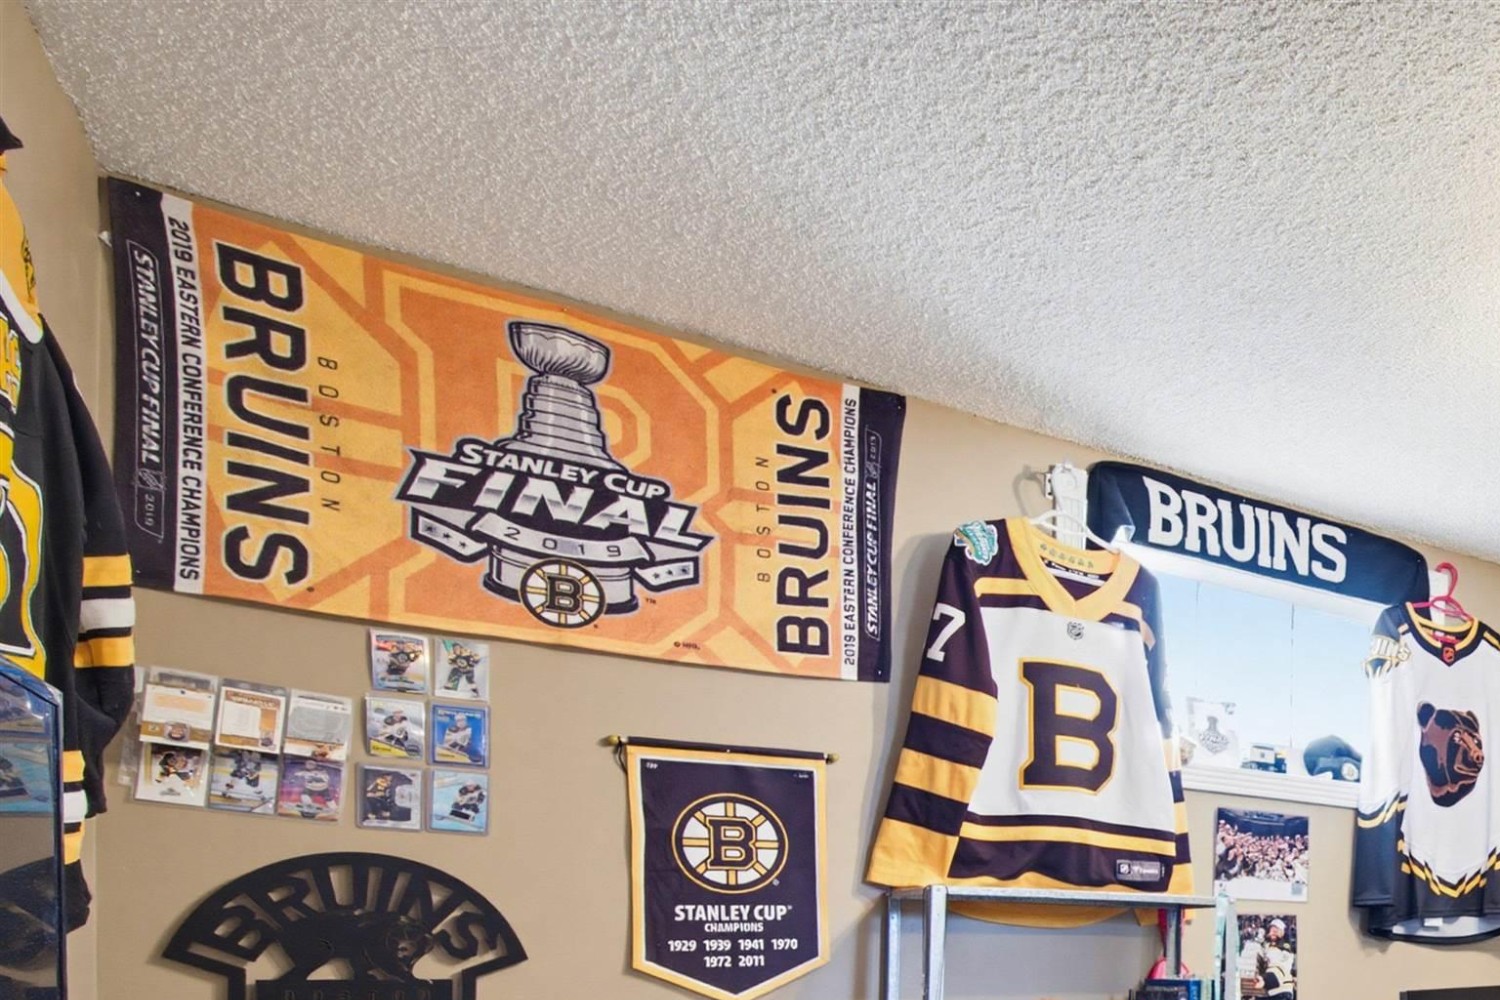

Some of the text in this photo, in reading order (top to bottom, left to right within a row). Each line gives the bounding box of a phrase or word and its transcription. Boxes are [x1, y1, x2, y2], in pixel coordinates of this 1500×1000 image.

[132, 248, 161, 353] STANLEY
[142, 353, 162, 402] CUP
[168, 215, 202, 581] 2019 EASTERN CONFERENCE CHAMPIONS
[215, 242, 310, 586] BRUINS
[142, 401, 163, 464] FINAL
[317, 356, 342, 512] BOSTON
[460, 444, 666, 499] STANLEY CUP
[407, 458, 703, 547] FINAL
[504, 526, 622, 558] 2019
[755, 456, 771, 582] BOSTON
[776, 394, 831, 656] BRUINS
[842, 399, 857, 665] 2019 EASTERN CONFERENCE CHAMPIONS
[865, 482, 877, 531] FINAL
[1143, 475, 1347, 583] BRUINS
[865, 532, 878, 564] CUP
[865, 564, 879, 635] STANLEY
[1019, 657, 1120, 796] B
[187, 864, 508, 966] BRUINS
[668, 938, 798, 952] 1929 1939 1941 1970
[674, 905, 788, 922] STANLEY CUP
[704, 922, 764, 933] CHAMPIONS
[704, 955, 765, 968] 1972 2011
